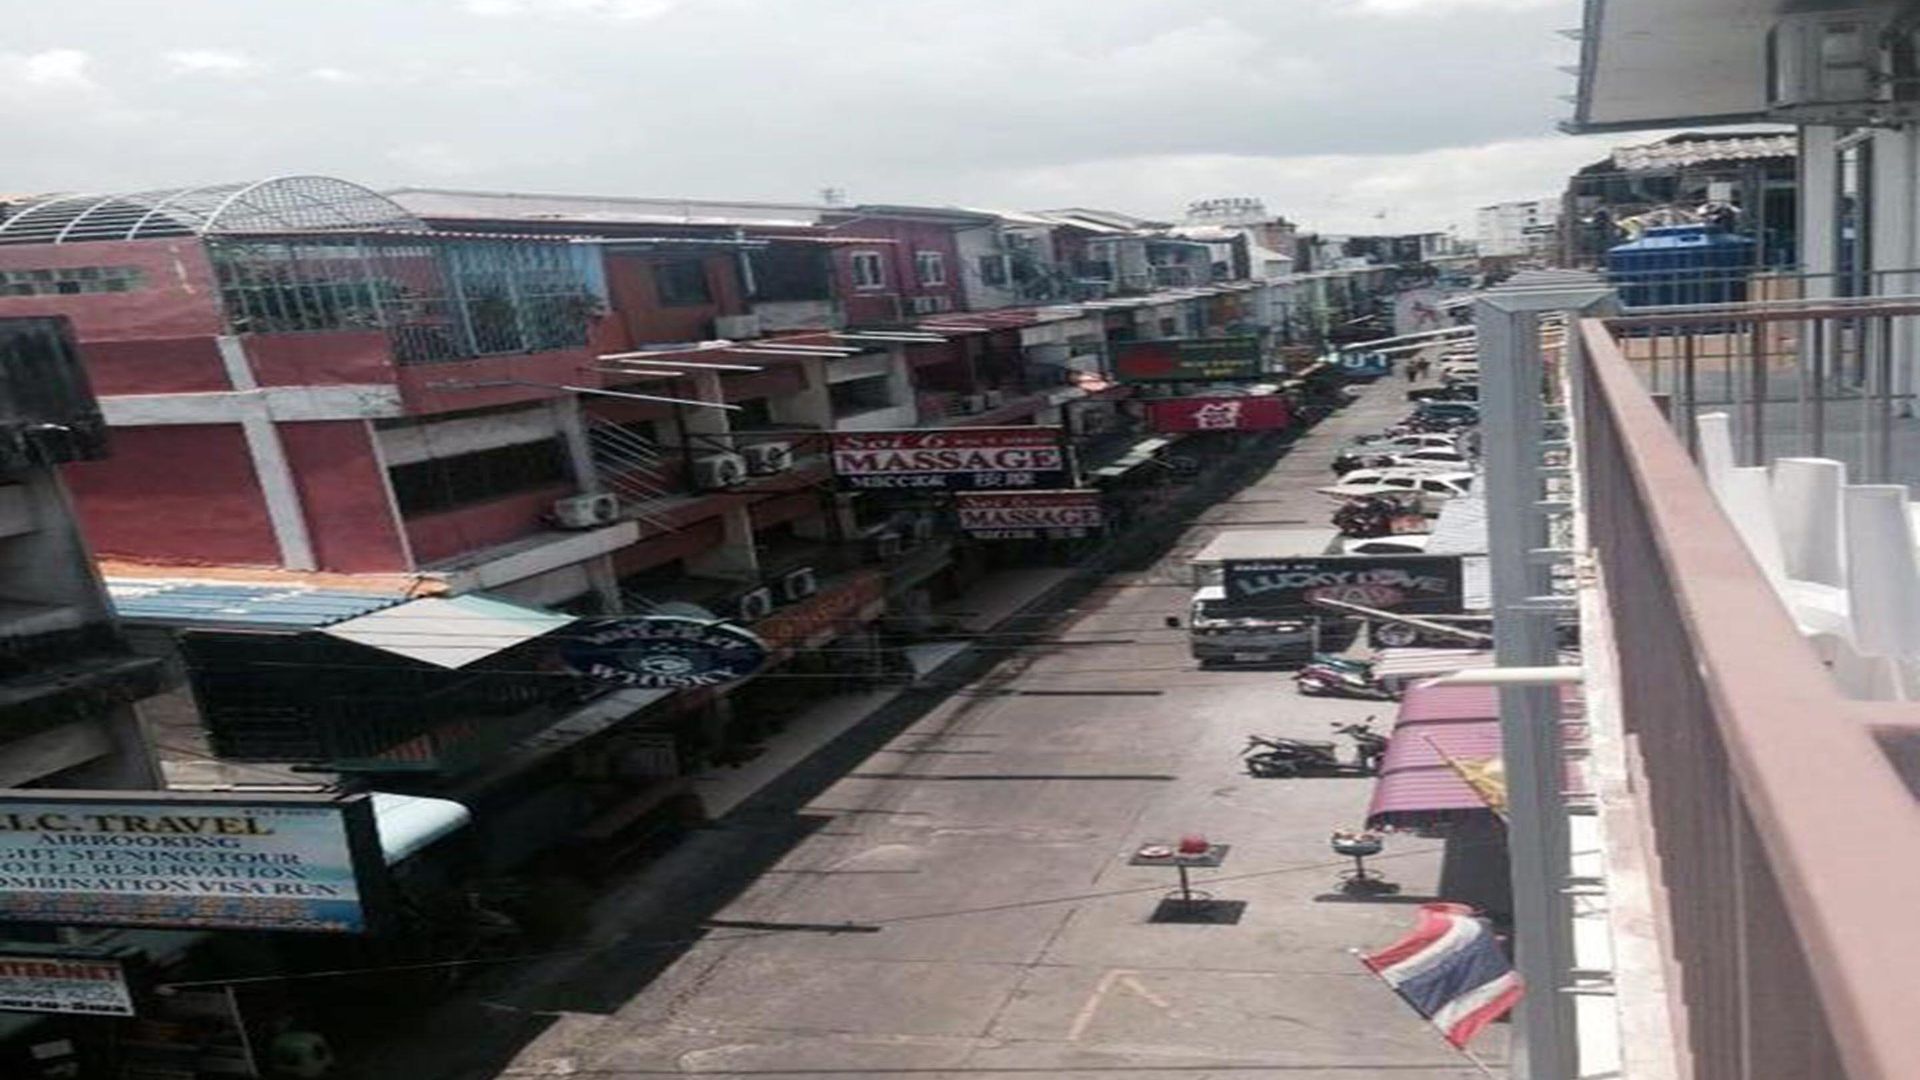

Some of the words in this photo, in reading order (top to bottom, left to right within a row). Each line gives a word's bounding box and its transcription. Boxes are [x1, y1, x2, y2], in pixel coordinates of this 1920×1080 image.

[840, 450, 1059, 472] MASSAGE
[964, 508, 1098, 526] MASSAGE
[1237, 570, 1352, 594] LUCKY
[590, 662, 741, 686] WHISKY
[85, 814, 274, 836] TRAVEL
[39, 833, 241, 849] AIRBOOKING
[216, 851, 303, 865] TOUR
[92, 863, 305, 879] RESERVATION
[198, 880, 265, 893] VISA
[274, 882, 340, 896] RUN
